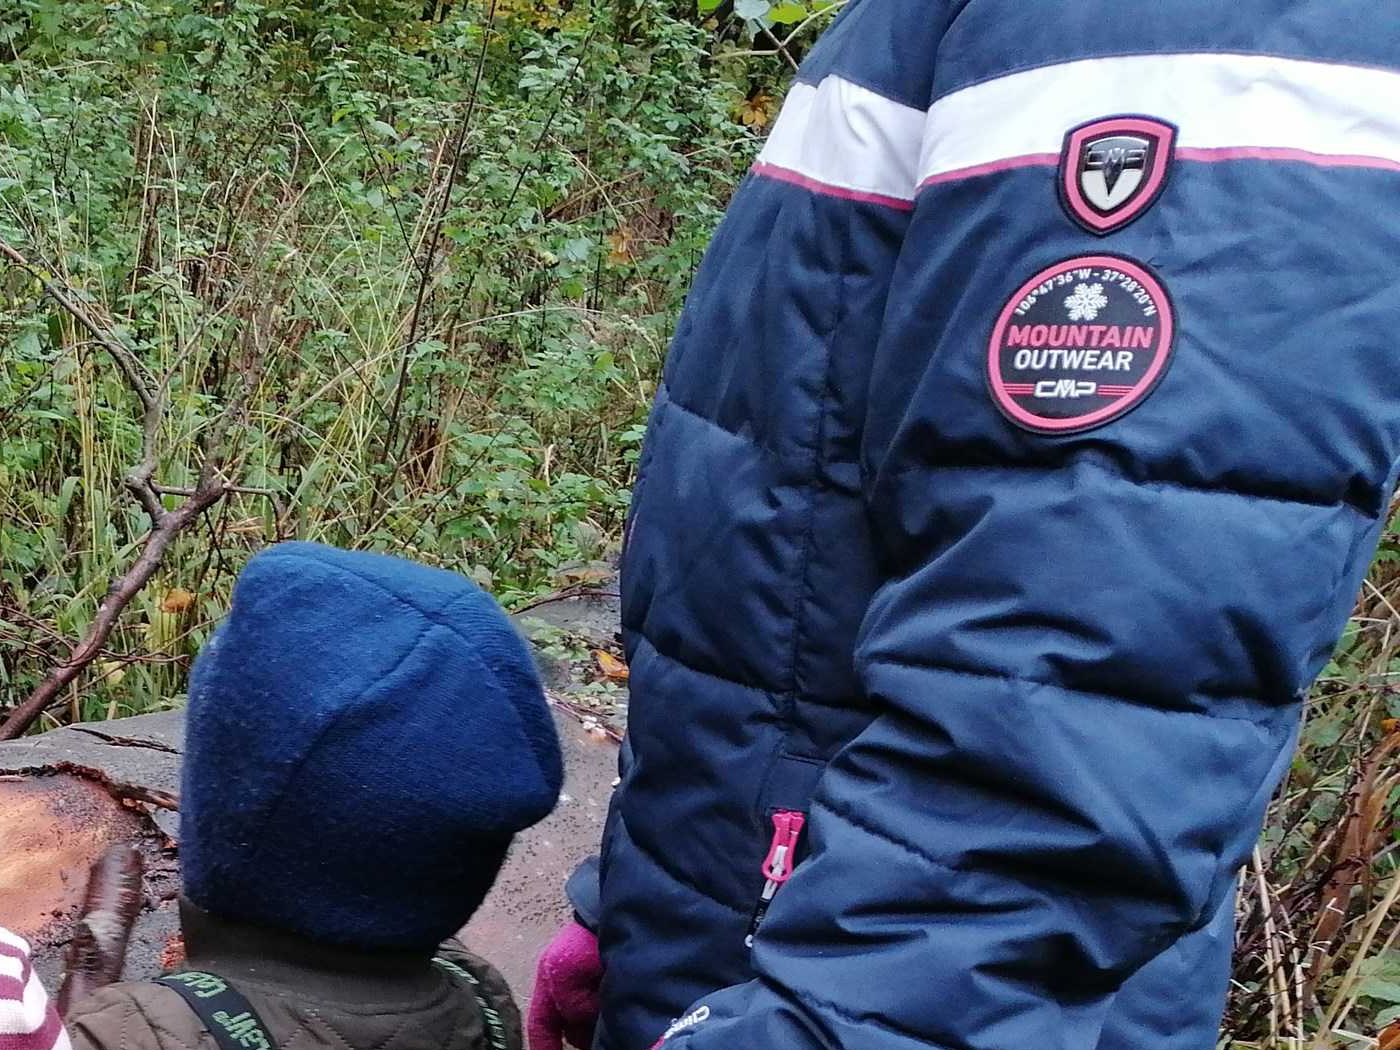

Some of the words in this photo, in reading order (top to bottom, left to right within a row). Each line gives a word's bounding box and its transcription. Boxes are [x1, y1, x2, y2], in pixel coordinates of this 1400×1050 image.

[1007, 325, 1154, 348] MOUNTAIN
[1014, 349, 1134, 371] OUTWEAR
[1034, 379, 1097, 398] CMP
